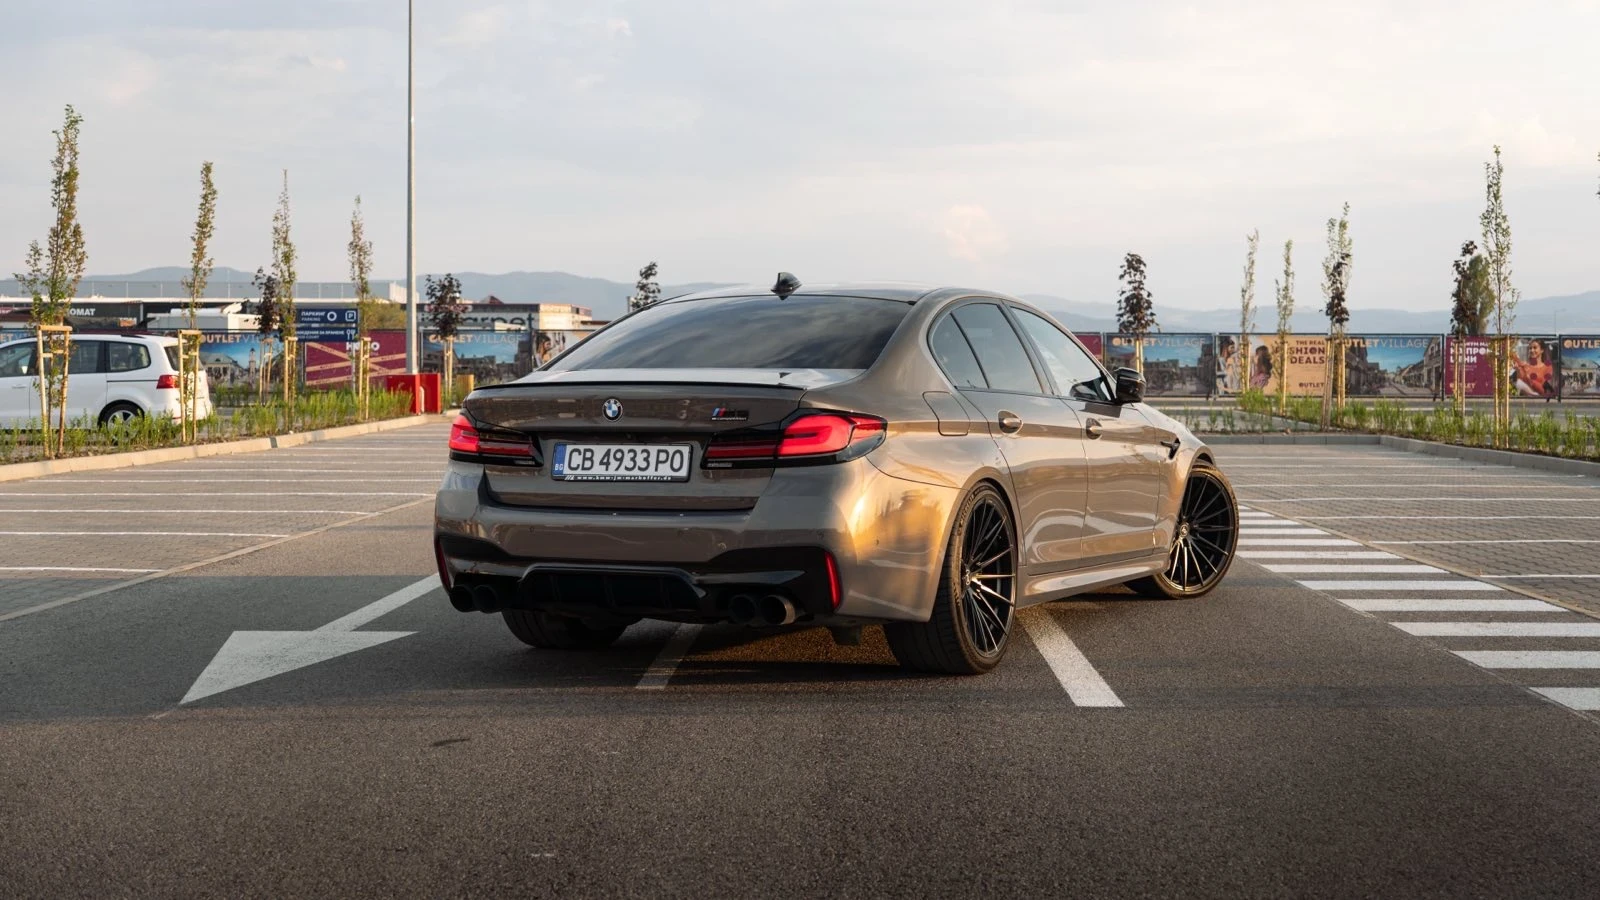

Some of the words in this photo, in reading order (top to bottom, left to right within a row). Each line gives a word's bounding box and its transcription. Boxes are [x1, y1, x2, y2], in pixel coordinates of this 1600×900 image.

[70, 308, 96, 316] OMAT
[1275, 346, 1326, 355] FSHION
[1290, 356, 1325, 365] DEALS
[567, 448, 595, 472] CB
[599, 448, 650, 473] 4933
[654, 449, 684, 473] PO
